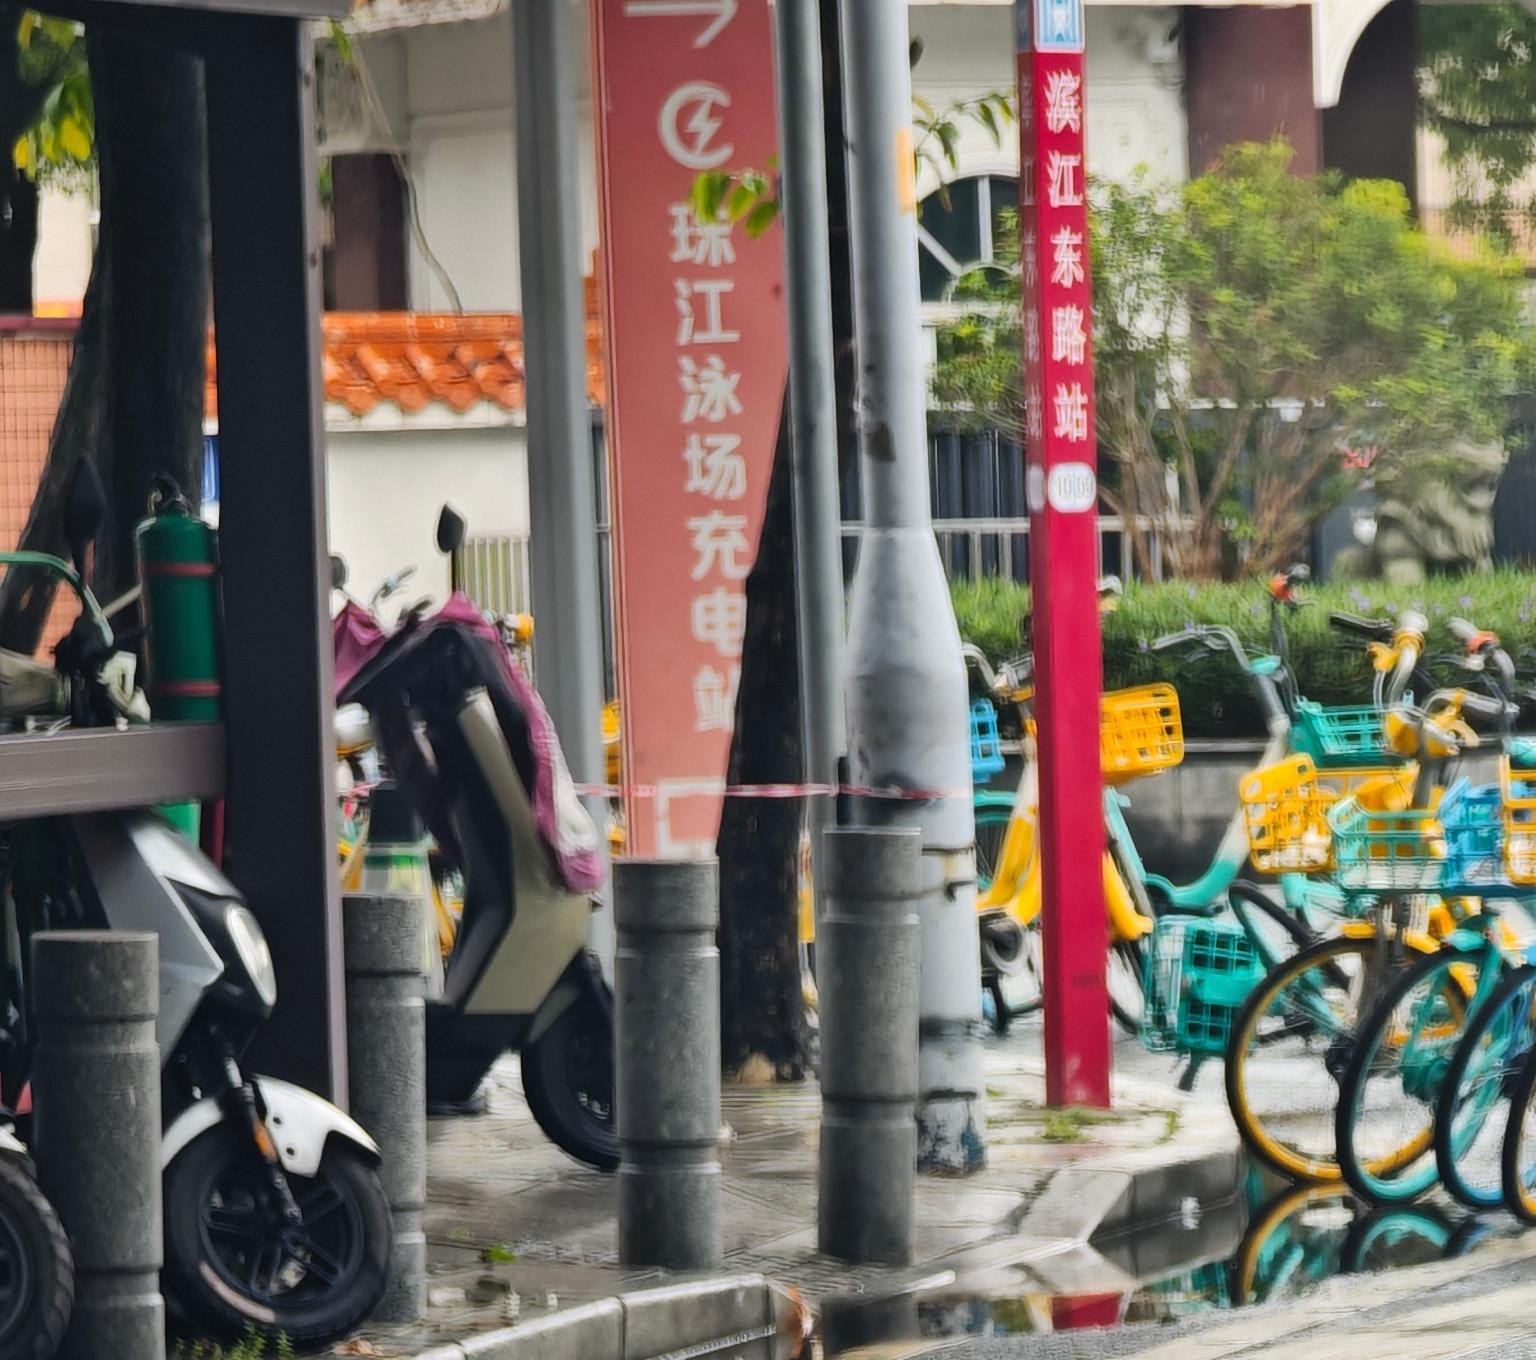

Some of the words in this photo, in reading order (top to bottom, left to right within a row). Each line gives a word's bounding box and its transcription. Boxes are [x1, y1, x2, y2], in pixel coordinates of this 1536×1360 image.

[668, 203, 751, 733] 珠江泳场充电站
[1044, 68, 1088, 442] 滨江东路站
